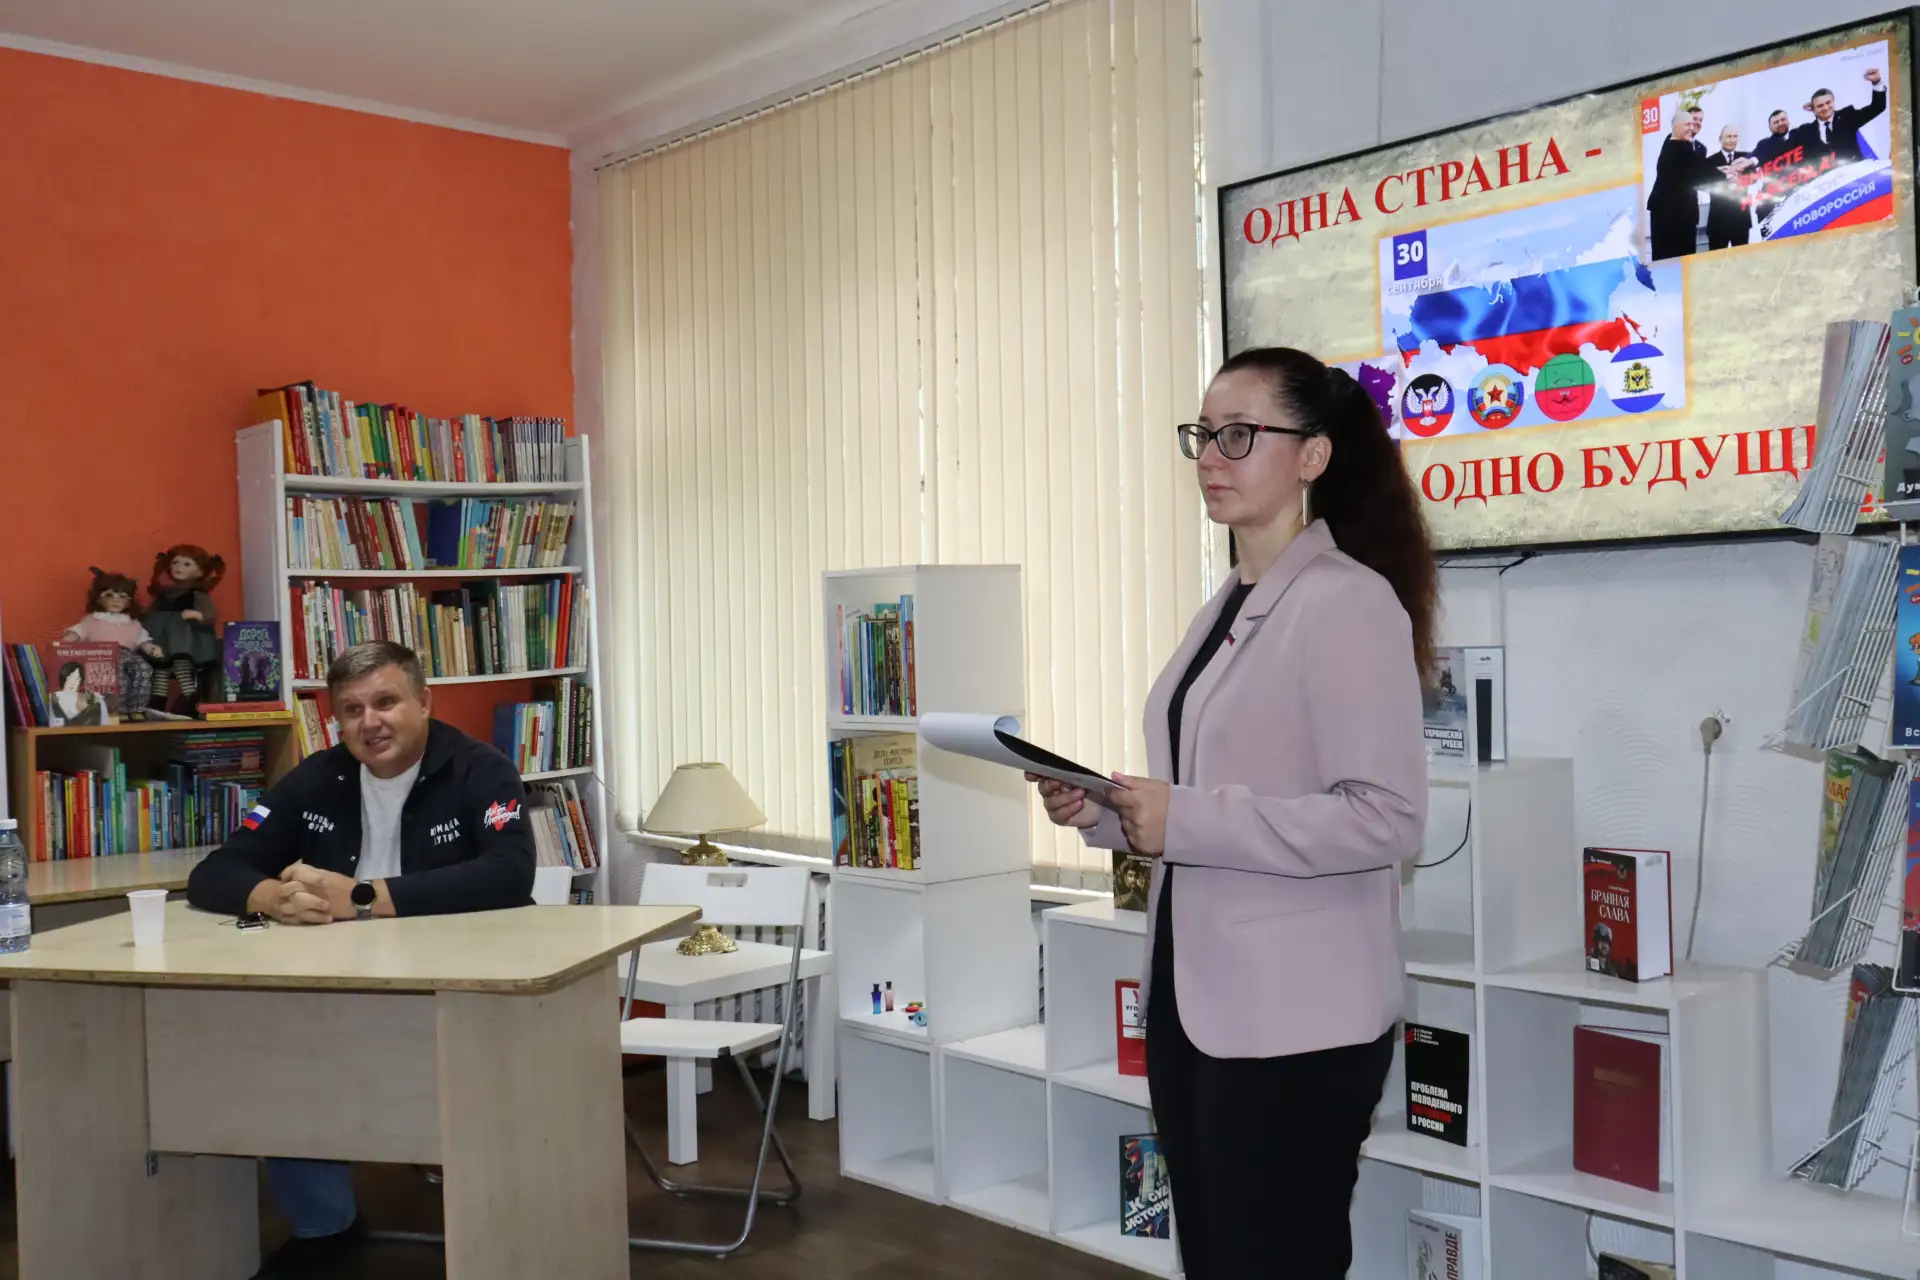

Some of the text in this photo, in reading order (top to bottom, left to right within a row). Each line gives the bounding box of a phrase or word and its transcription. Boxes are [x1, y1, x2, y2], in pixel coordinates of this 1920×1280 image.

[1643, 106, 1658, 125] 30
[1243, 186, 1362, 248] ОДНА
[1374, 136, 1570, 214] СТРАНА
[1793, 180, 1876, 230] НОВОРОССИЯ
[1397, 240, 1424, 266] 30
[1388, 275, 1444, 296] сентября
[1421, 451, 1565, 509] ОДНО
[1443, 739, 1464, 748] РУБЕЖ
[1591, 889, 1630, 909] БРАННАЯ
[1599, 904, 1630, 924] СЛАВА
[1411, 1081, 1448, 1099] ПРОБЛЕМА
[1411, 1092, 1463, 1115] МОЛОДЕЖНОГО
[1411, 1114, 1444, 1133] В РОССИИ
[1445, 1230, 1459, 1280] ПРАВДЕ
